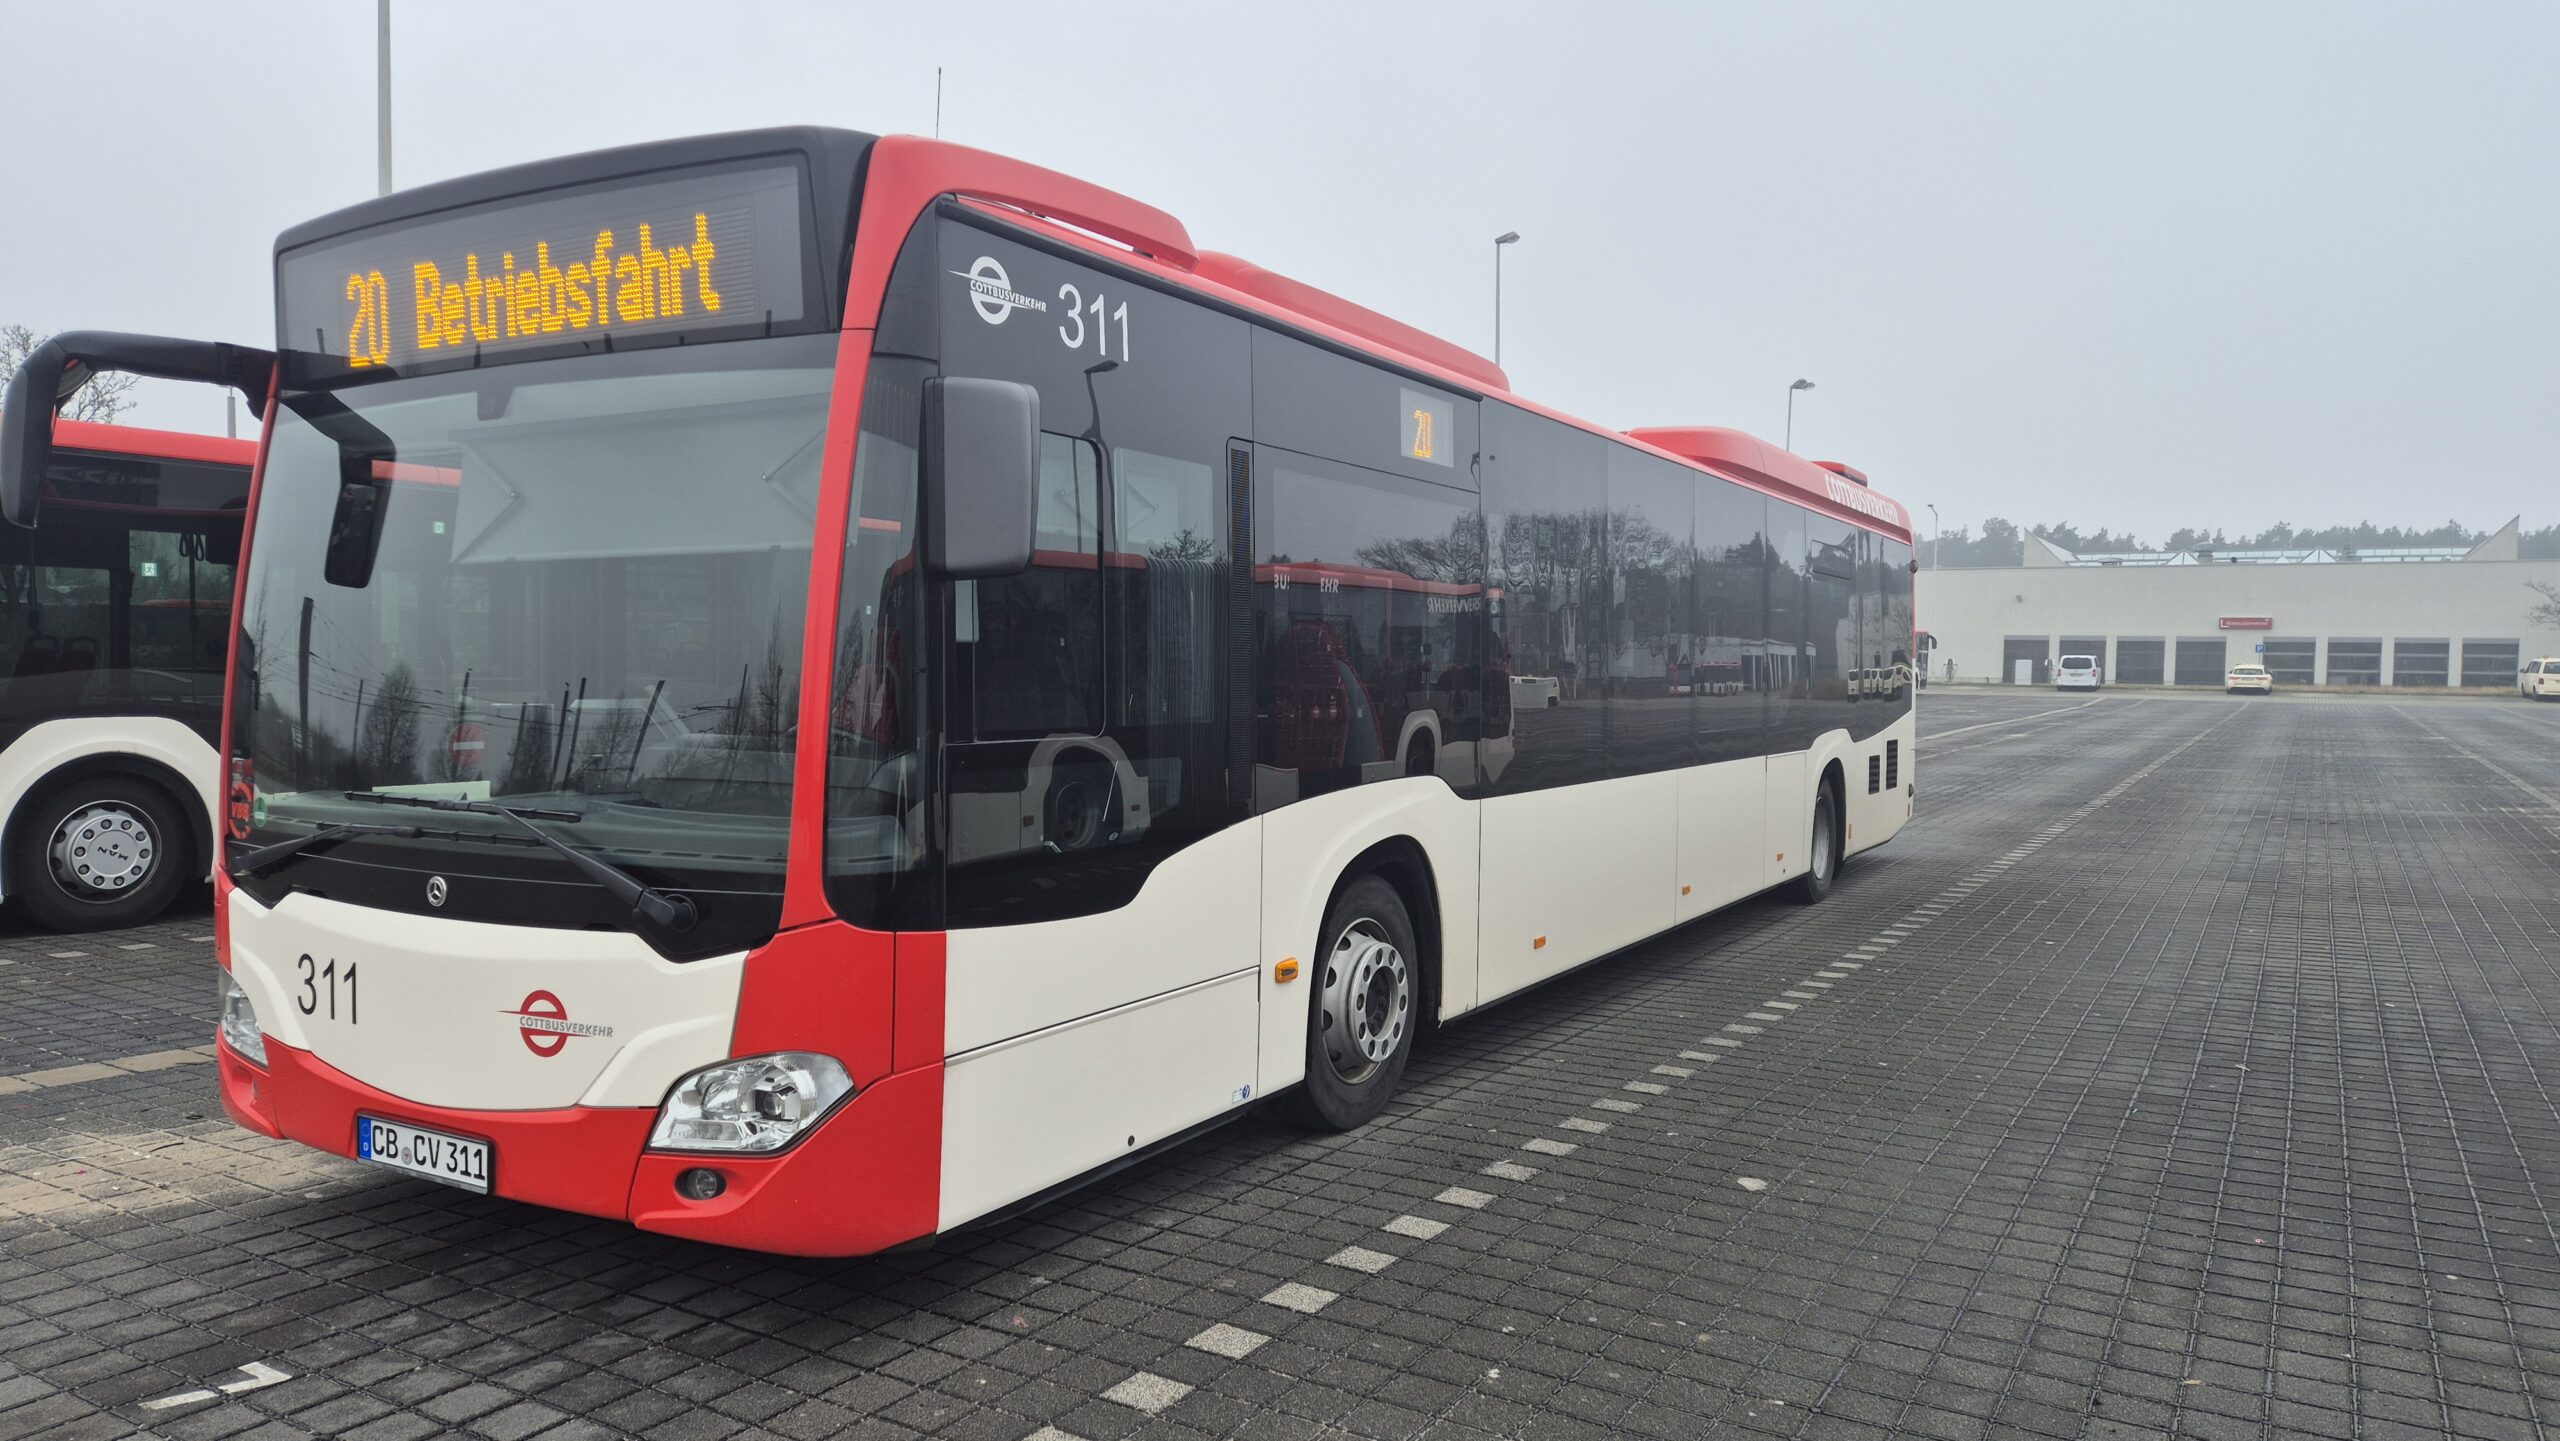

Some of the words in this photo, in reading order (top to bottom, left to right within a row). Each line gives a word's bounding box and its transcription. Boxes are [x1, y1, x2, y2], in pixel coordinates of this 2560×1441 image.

[346, 269, 391, 367] 20
[414, 212, 721, 349] Betriebsfahrt
[969, 279, 1047, 313] COTTBUSVERKEHR
[1058, 283, 1129, 362] 311
[1413, 409, 1433, 458] 20
[97, 845, 129, 861] MAN
[297, 953, 358, 1025] 311
[519, 1015, 614, 1038] COTTBUSVERKEHR
[372, 1124, 399, 1159] CB
[413, 1134, 441, 1169] CV
[446, 1141, 486, 1181] 311
